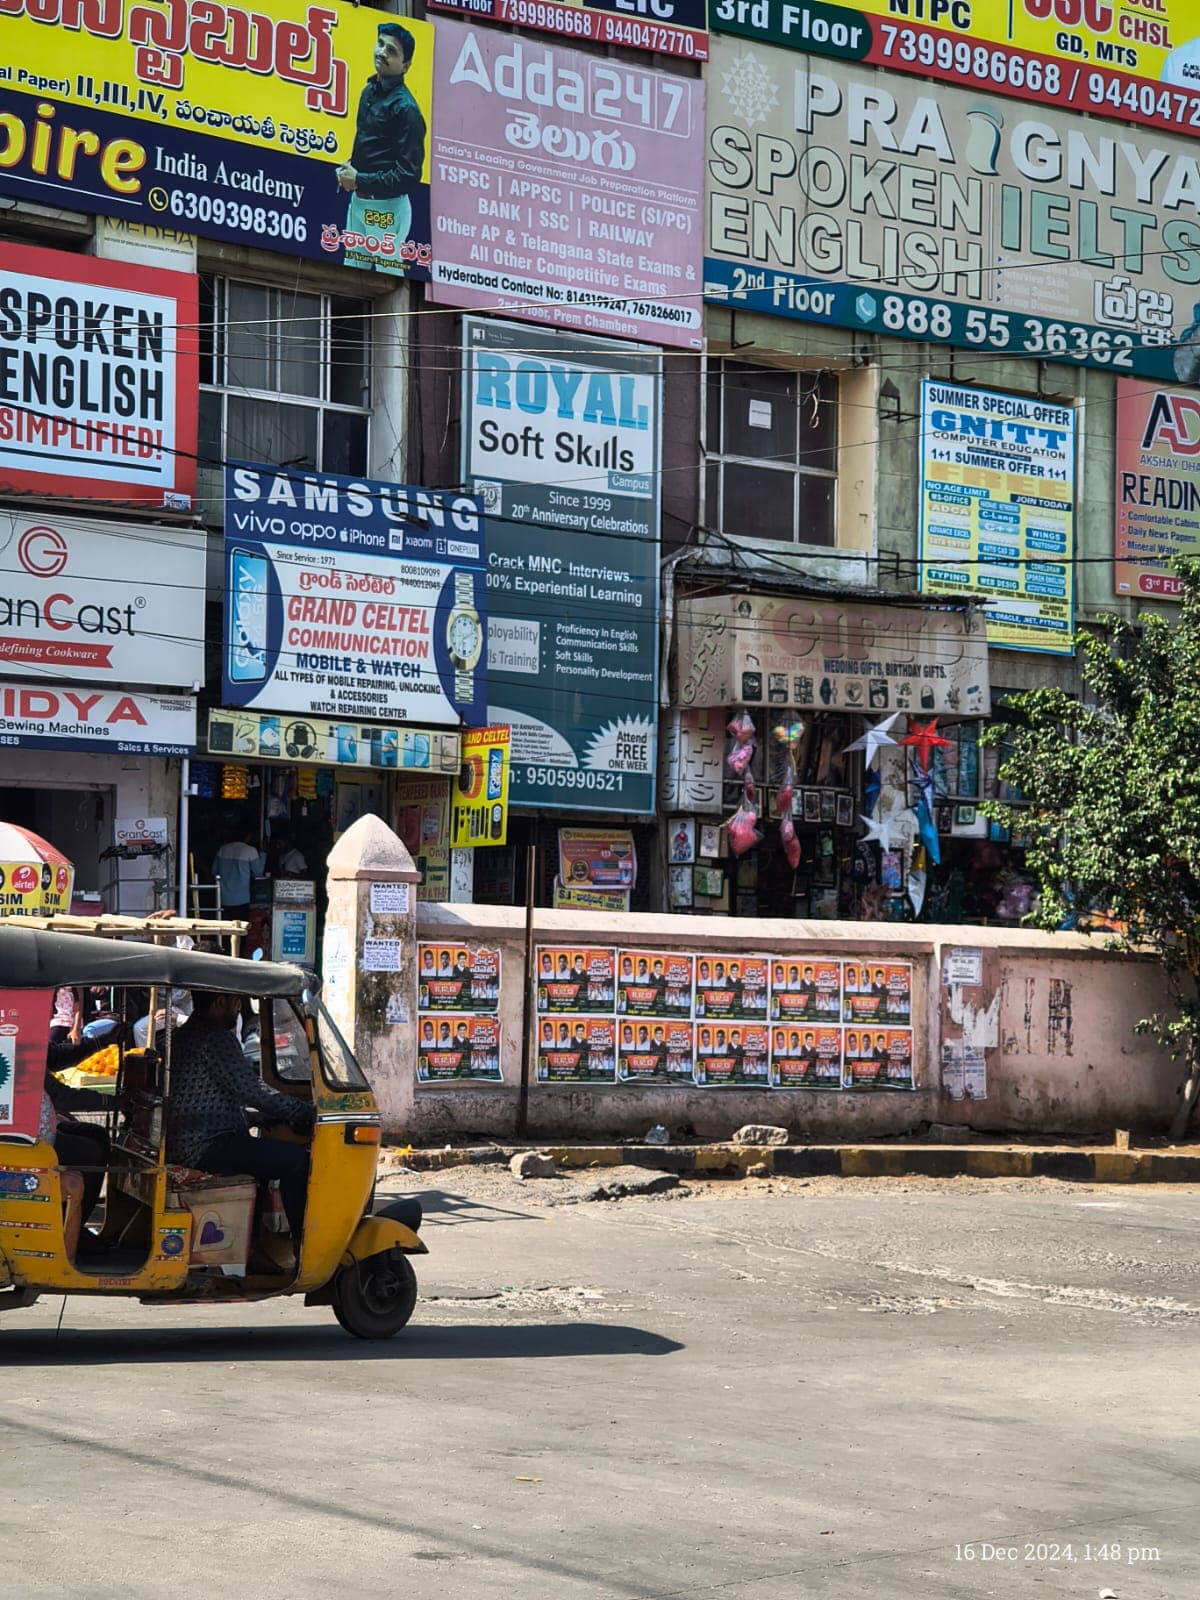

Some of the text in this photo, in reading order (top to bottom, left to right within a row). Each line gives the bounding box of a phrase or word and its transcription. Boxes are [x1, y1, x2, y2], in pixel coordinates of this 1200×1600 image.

[501, 0, 693, 56] 7399986668 9440472770
[1119, 14, 1173, 49] CHSL
[716, 0, 1061, 96] 3rd Floor 7399986668
[1056, 32, 1137, 68] GD, MTS
[18, 69, 71, 97] Paper)
[175, 98, 277, 141] పంచాయతీ
[505, 108, 636, 171] తెలుగు
[794, 70, 1200, 216] PRA GNYA
[155, 147, 306, 208] India Academy
[474, 151, 598, 185] Leading Government Job
[438, 164, 692, 235] TSPSC APPSC POLICE (SI/PC)
[708, 124, 1200, 286] SPOKEN IELTS
[170, 190, 308, 243] 6309398306
[478, 198, 655, 248] BANK SSC RAILWAY
[437, 216, 682, 278] Other AP Telangana State Exams
[709, 191, 983, 300] ENGLISH
[470, 244, 668, 296] All Other Competitive Exams
[438, 265, 693, 324] Hyderabad Contact No: 7678266017
[0, 287, 163, 363] SPOKEN
[553, 309, 639, 336] Prem Chambers
[732, 267, 1134, 368] 2nd Floor 888 55 36362
[0, 346, 163, 421] ENGLISH
[476, 350, 649, 430] ROYAL
[929, 387, 1070, 426] SUMMER SPECIAL OFFER
[0, 407, 162, 460] SIMPLIFIED!
[931, 409, 1067, 450] GNITT
[478, 420, 634, 472] Soft Skills
[932, 431, 997, 448] COMPUTER
[1001, 442, 1066, 460] EDUCATION
[955, 452, 1005, 470] SUMMER
[1008, 461, 1044, 477] OFFER
[1140, 454, 1179, 471] AKSHAY
[611, 475, 649, 490] Campus
[942, 484, 988, 497] AGE LIMIT
[233, 468, 480, 532] SAMSUNG
[549, 491, 612, 512] Since 1999
[1016, 496, 1068, 510] JOIN TODAY
[233, 510, 433, 548] vivo oppo iPhone xiaomi
[511, 503, 649, 535] 20th Anniversary Celebrations
[1128, 511, 1173, 526] Comfortable
[1032, 530, 1061, 541] WINGS
[1127, 541, 1180, 554] Mineral Water
[1128, 525, 1197, 543] Daily News Papers
[277, 550, 336, 565] Since Service 1971
[488, 552, 634, 583] Crack MNC Interviews.
[300, 569, 342, 590] గ్రాండ్
[931, 571, 967, 582] TYPING
[515, 577, 643, 608] Experiential Learning
[287, 595, 430, 634] GRAND CELTEL
[287, 628, 429, 659] COMMUNICATION
[555, 636, 639, 653] Communication Skills
[556, 623, 638, 641] Proficiency English
[46, 646, 98, 660] Cookware
[296, 653, 421, 679] MOBILE WATCH
[500, 650, 538, 671] Training
[555, 651, 593, 663] Soft Skills
[274, 669, 441, 694] ALL TYPES OF MOBILE REPAIRING, UNLOCKING
[556, 664, 653, 682] Personality Development
[824, 659, 922, 678] WEDDING BIRTHDAY
[310, 701, 408, 719] WATCH REPAIRING CENTER
[338, 689, 389, 704] ACCESSORIES
[0, 719, 110, 736] Sewing Machines
[616, 731, 647, 744] Attend
[118, 742, 189, 755] Sales Services
[616, 744, 647, 761] FREE
[526, 767, 623, 791] 9505990521
[608, 760, 648, 771] ONE WEEK
[117, 829, 163, 839] GranCast
